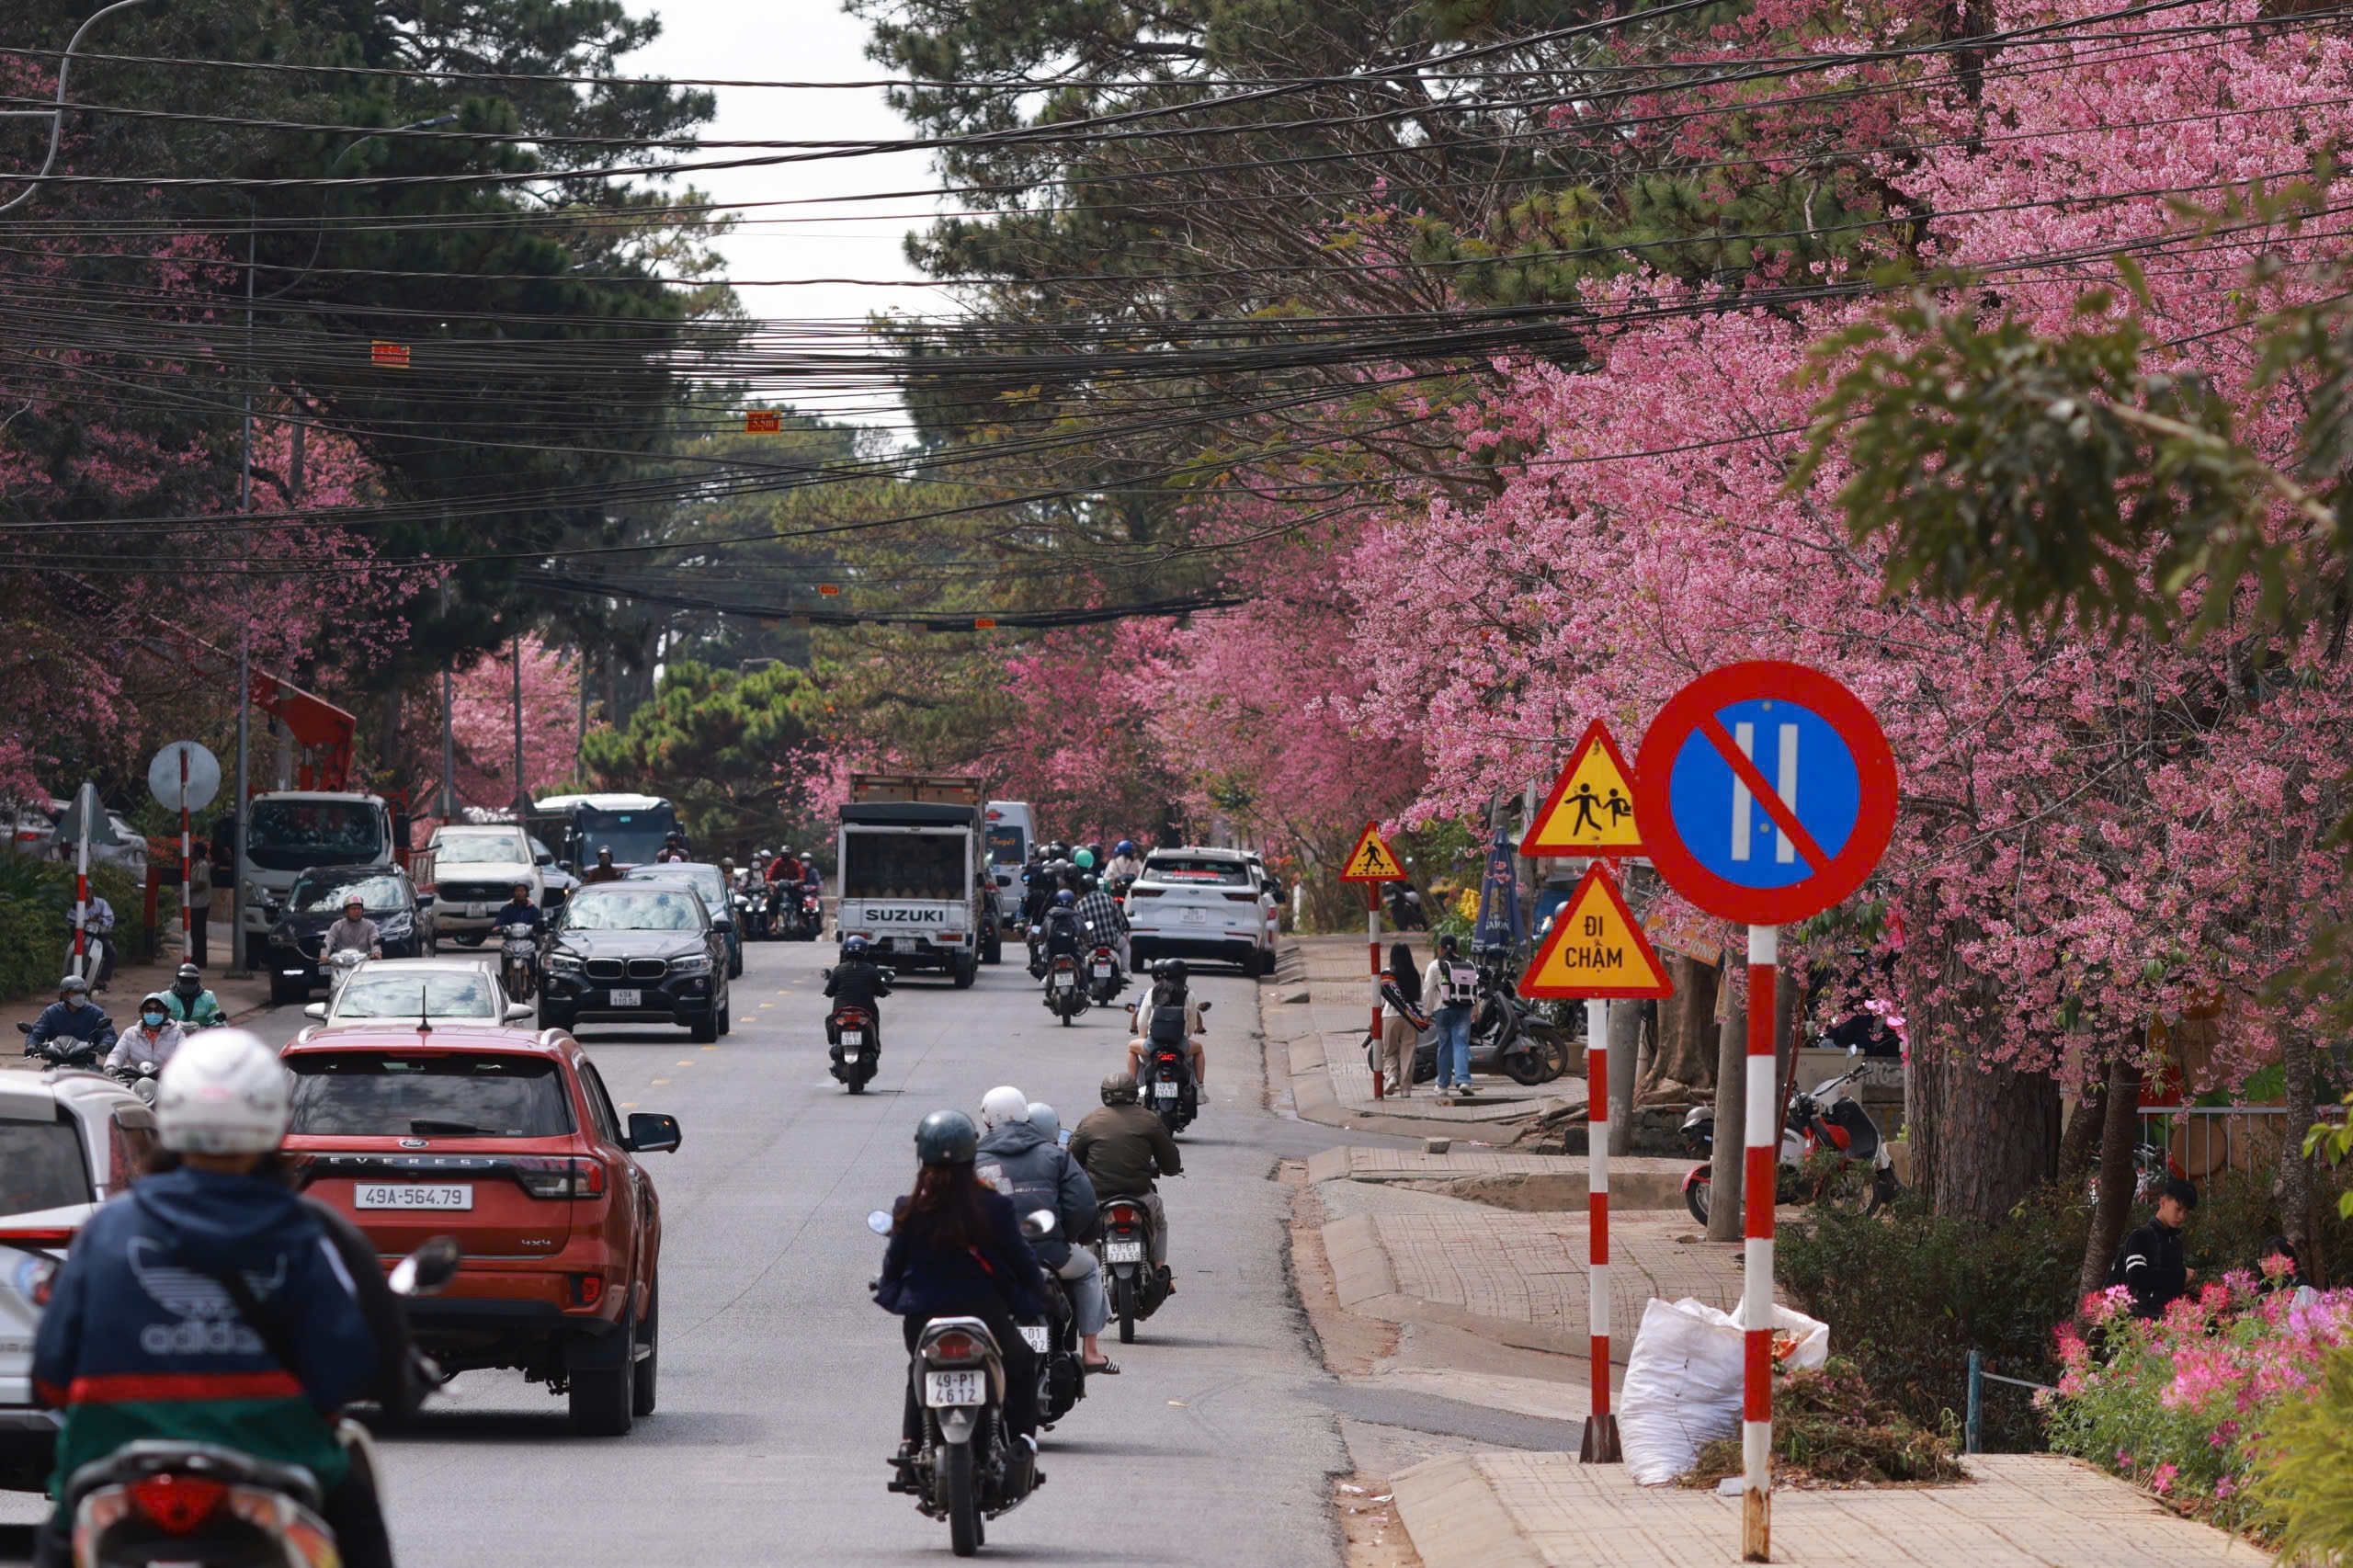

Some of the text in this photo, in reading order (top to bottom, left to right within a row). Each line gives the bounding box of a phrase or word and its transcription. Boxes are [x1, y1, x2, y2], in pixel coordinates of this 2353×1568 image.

[866, 909, 944, 923] SUZUKI
[1584, 915, 1604, 937] ĐI
[1565, 938, 1622, 973] CHẬM
[330, 1157, 498, 1165] EVEREST
[365, 1188, 462, 1205] 49A-564.79
[936, 1373, 974, 1388] 49-P1
[936, 1388, 976, 1403] 4612
